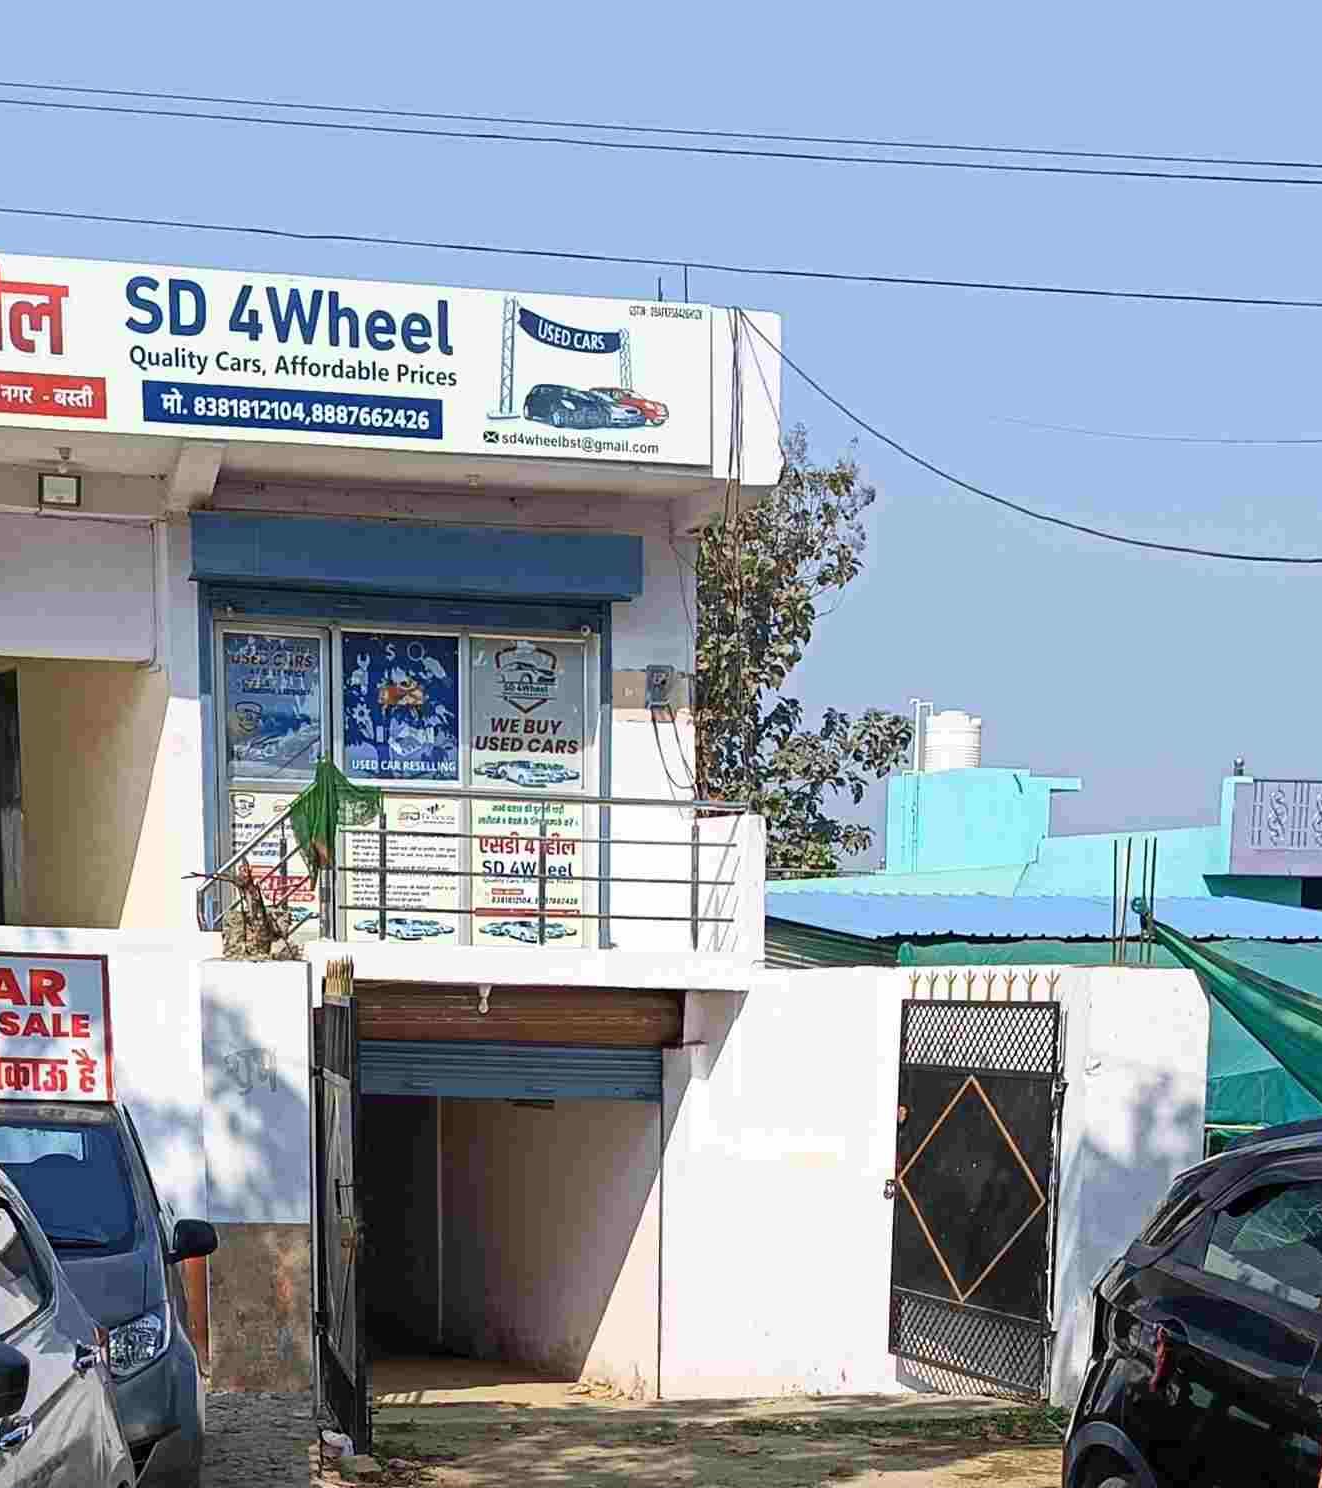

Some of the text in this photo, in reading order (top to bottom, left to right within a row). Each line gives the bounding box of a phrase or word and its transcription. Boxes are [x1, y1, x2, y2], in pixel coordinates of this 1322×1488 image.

[125, 276, 454, 356] SD 4Wheel
[537, 319, 606, 350] USED CARS
[129, 345, 458, 387] Quality Cars, Affordable Prices
[0, 385, 34, 405] नगर
[53, 385, 94, 409] बस्ती
[160, 388, 188, 415] मो.
[501, 431, 660, 455] sd4wheelbst@gmail.com
[490, 718, 562, 735] WE BUY
[475, 736, 579, 755] USED CARS
[351, 759, 456, 773] USED CAR RESELLING
[478, 831, 520, 855] एसडी
[524, 839, 536, 855] 4
[482, 860, 574, 879] SD 4Weel
[70, 1048, 98, 1094] है
